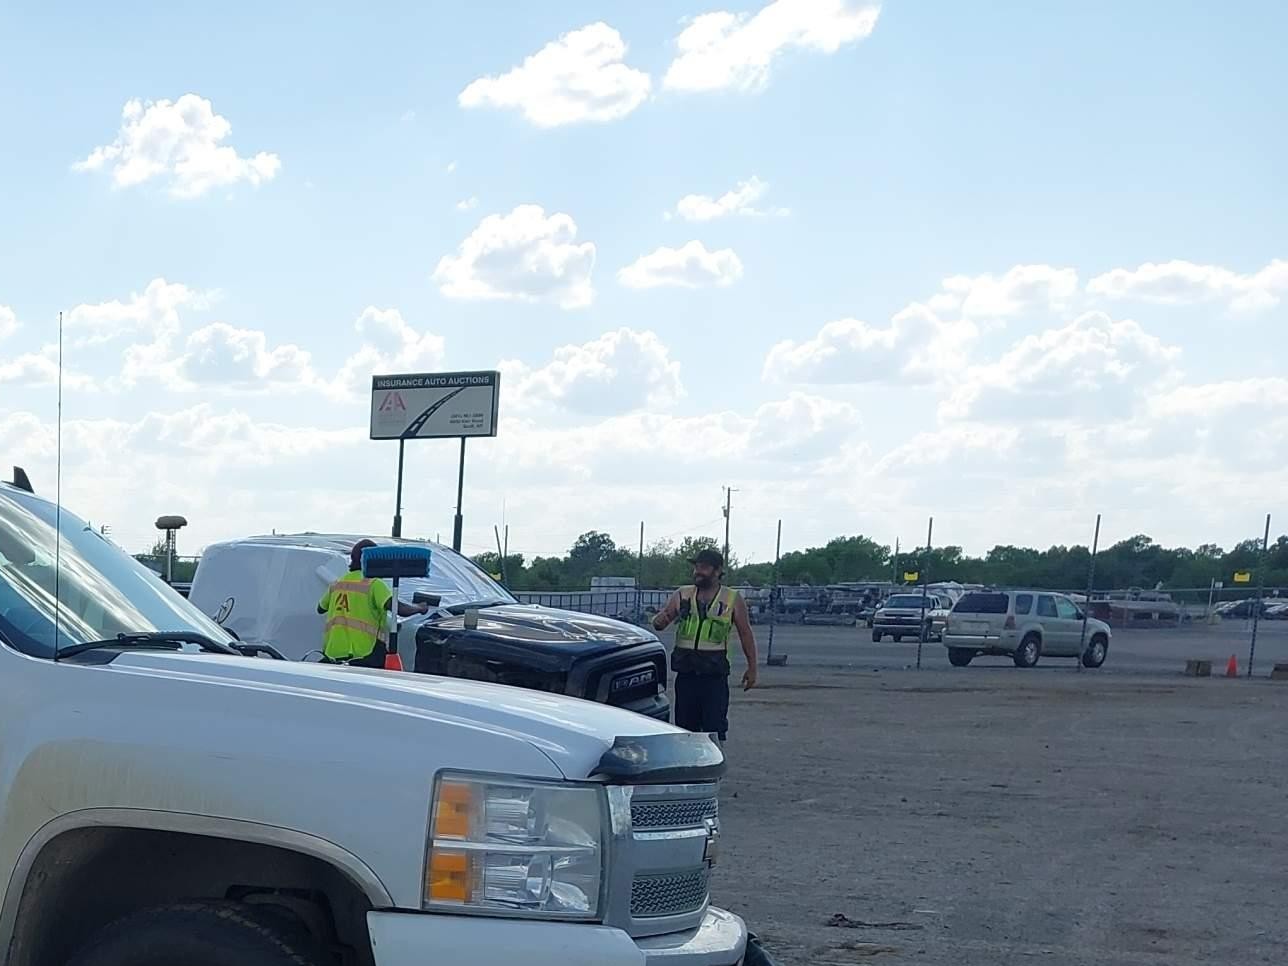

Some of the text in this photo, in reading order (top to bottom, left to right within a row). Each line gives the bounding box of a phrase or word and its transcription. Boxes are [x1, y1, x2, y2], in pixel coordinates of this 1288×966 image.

[378, 376, 489, 387] INSURANCE AUTO AUCTIONS
[615, 672, 653, 689] RAM
